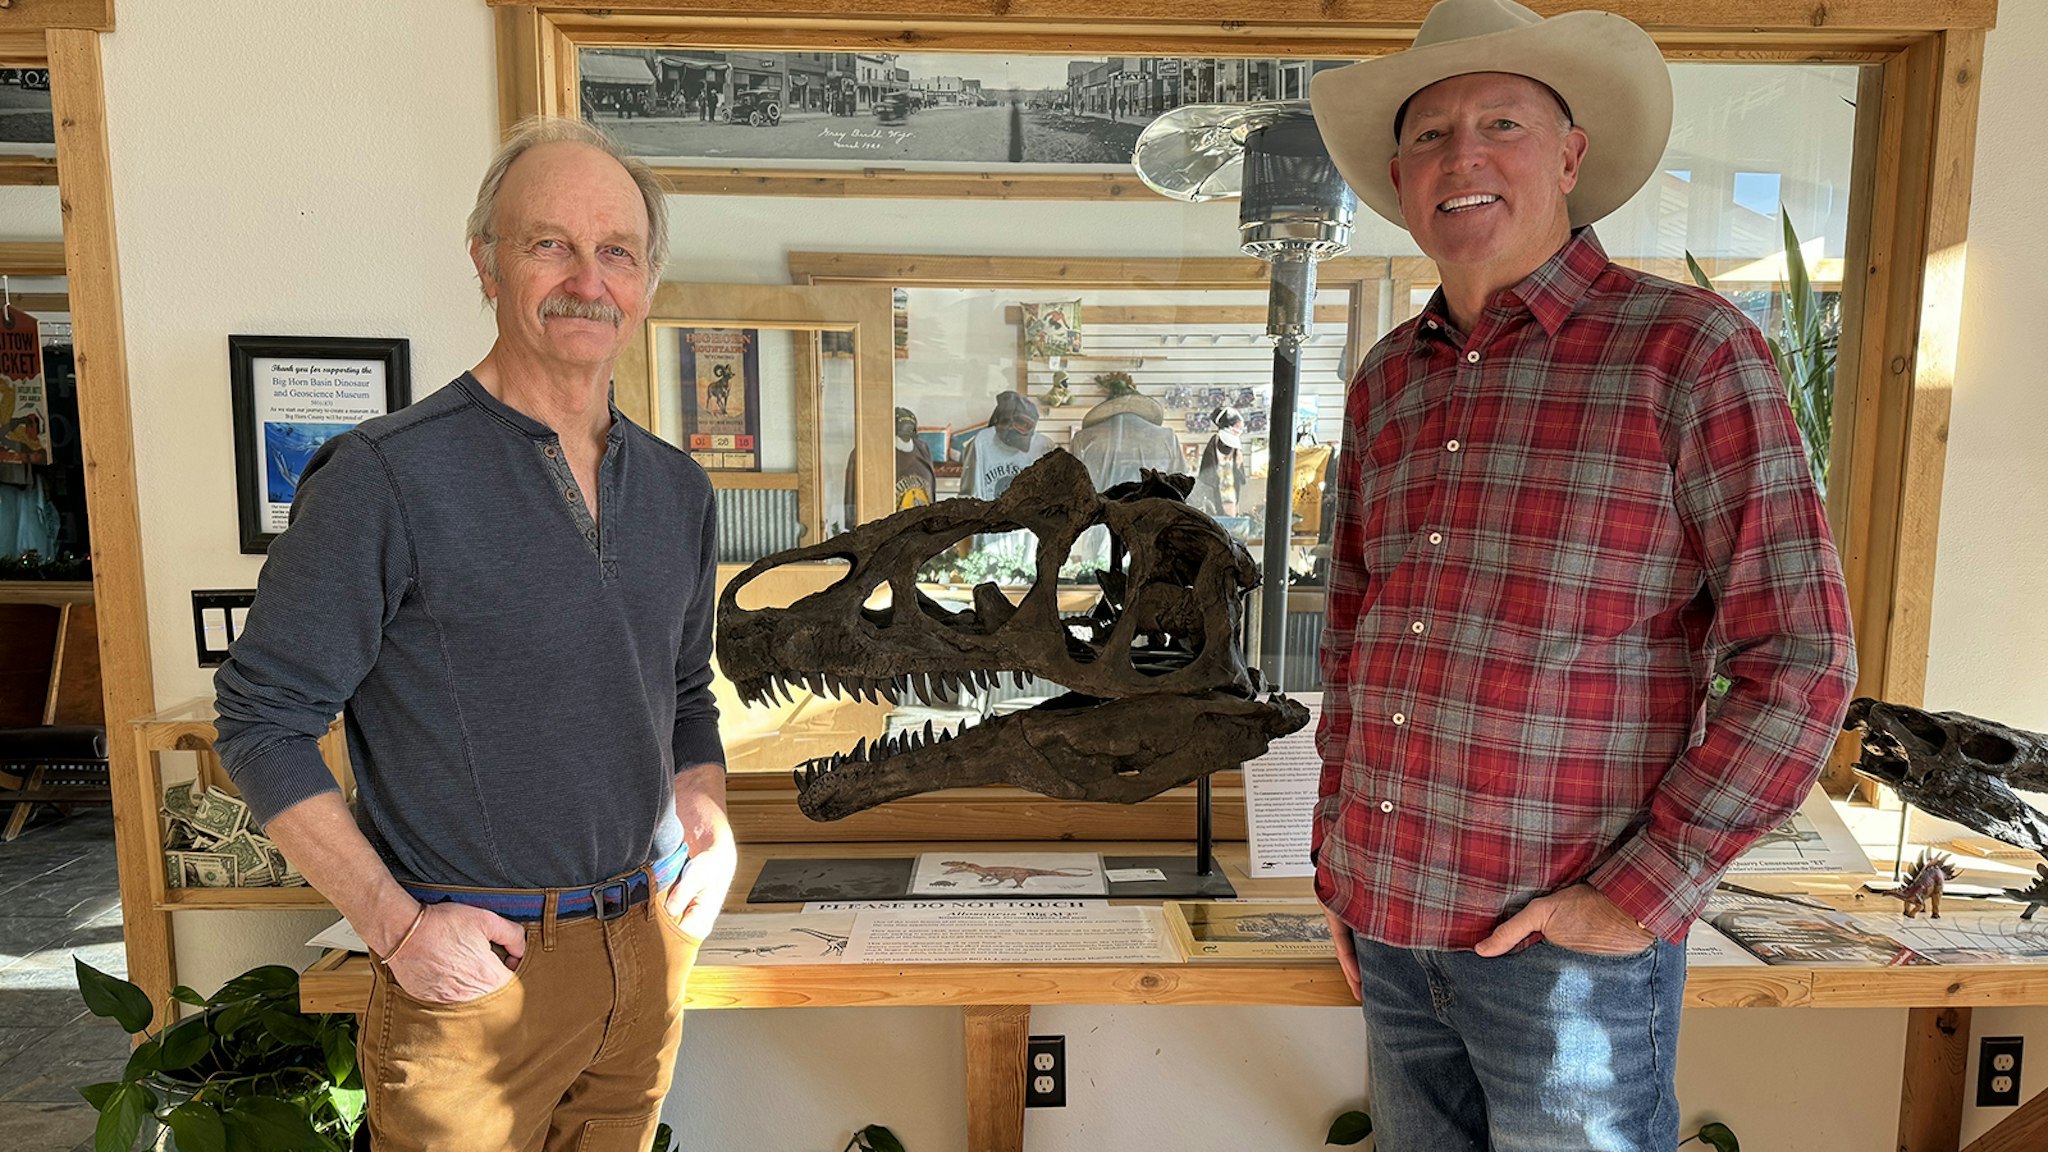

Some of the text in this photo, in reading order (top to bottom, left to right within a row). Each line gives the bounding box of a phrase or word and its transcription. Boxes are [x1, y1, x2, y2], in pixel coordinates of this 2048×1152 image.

[0, 352, 35, 374] CKET
[271, 364, 294, 373] Thank
[310, 365, 321, 374] for
[322, 366, 360, 375] supporting
[361, 366, 372, 374] the
[272, 377, 370, 387] Big Horn Basin Dinosaur
[273, 389, 370, 399] and Geoscience Museum
[984, 463, 1022, 486] JURAS
[818, 902, 905, 911] PLEASE
[951, 901, 999, 909] NOT
[1002, 901, 1085, 909] TOUCH
